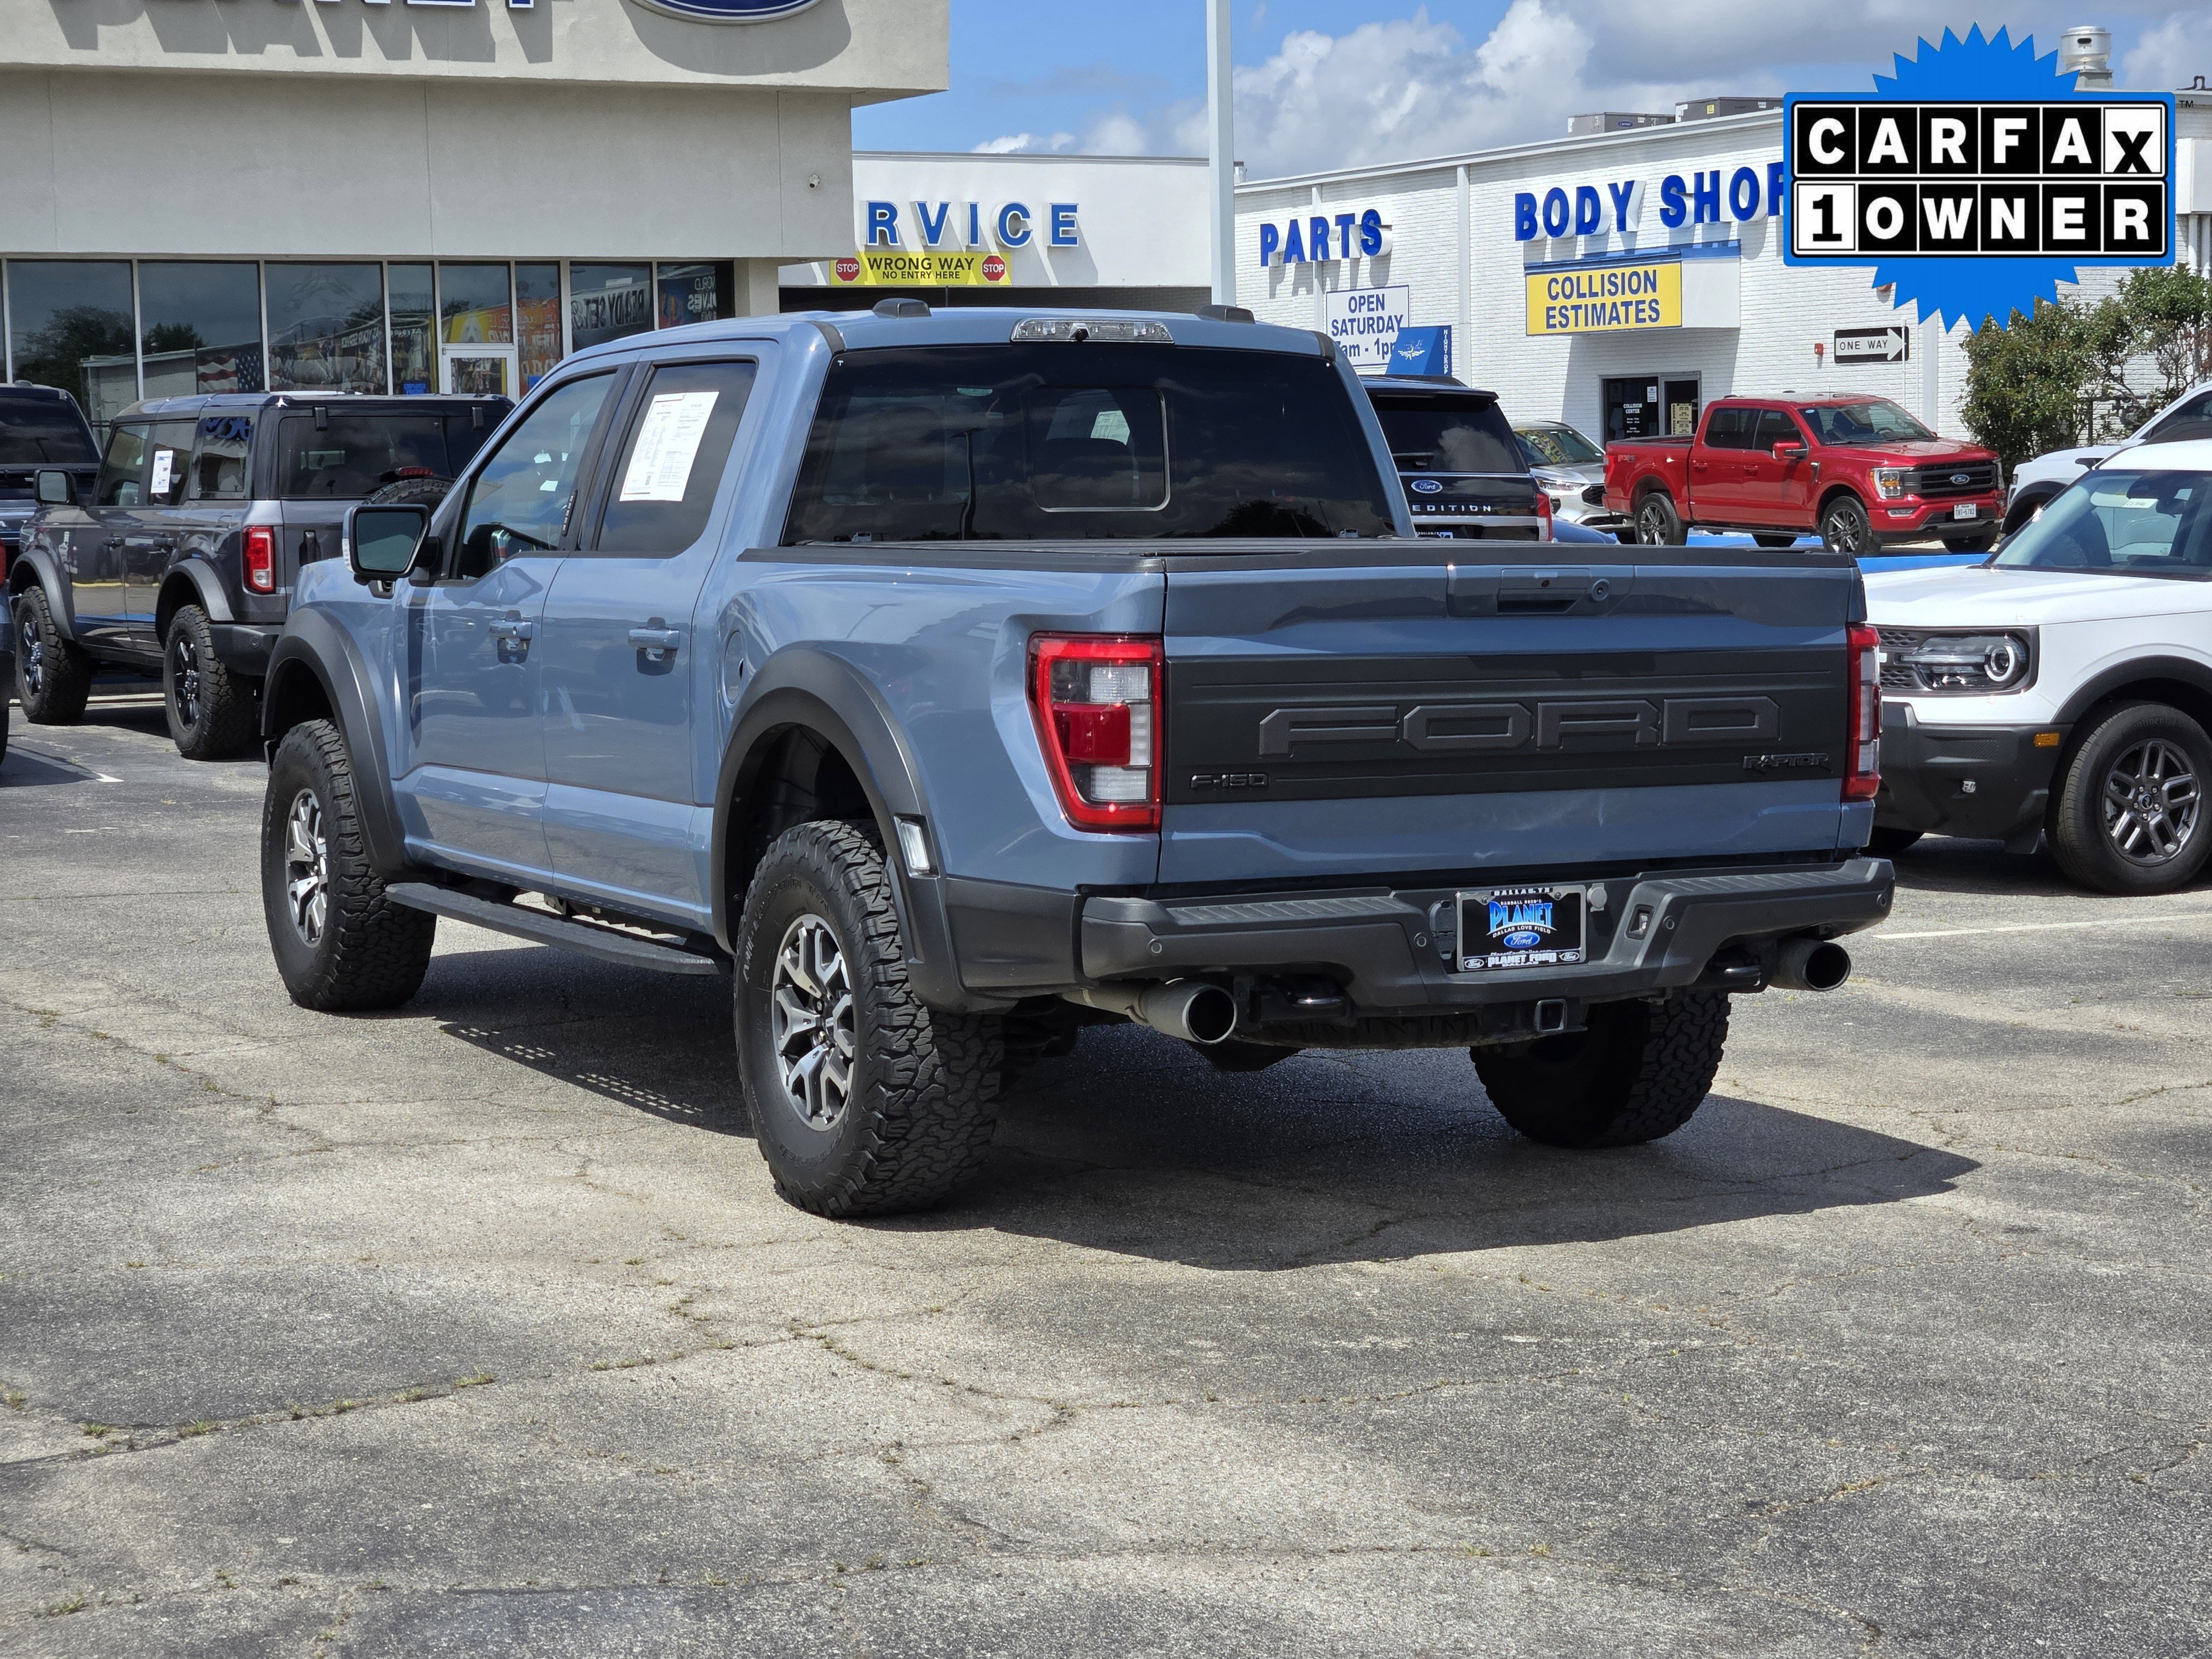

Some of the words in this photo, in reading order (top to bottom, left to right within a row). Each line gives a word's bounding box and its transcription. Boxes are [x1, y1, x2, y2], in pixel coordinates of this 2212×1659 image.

[1515, 180, 1635, 241] BODY
[867, 200, 1079, 248] RVICE
[1260, 208, 1383, 267] PARTS
[836, 263, 859, 273] STOP
[867, 257, 932, 271] WRONG
[938, 257, 974, 270] WAY
[882, 271, 898, 279] NO
[901, 270, 933, 279] ENTRY
[935, 270, 960, 279] HERE
[983, 263, 1005, 273] STOP
[1547, 269, 1657, 301] COLLISION
[1348, 293, 1385, 314] OPEN
[1546, 298, 1660, 329] ESTIMATES
[1331, 314, 1404, 337] SATURDAY
[1839, 341, 1860, 351] ONE
[1867, 339, 1888, 349] WAY
[1259, 696, 1781, 759] FORD
[1743, 752, 1833, 774] RAPTOR
[1191, 774, 1269, 789] F-150
[1489, 900, 1553, 933] PLANET
[1492, 926, 1515, 938] DALLAS
[1534, 926, 1551, 935] FIELD
[1488, 954, 1527, 967] PLANET
[1528, 952, 1557, 963] FORD
